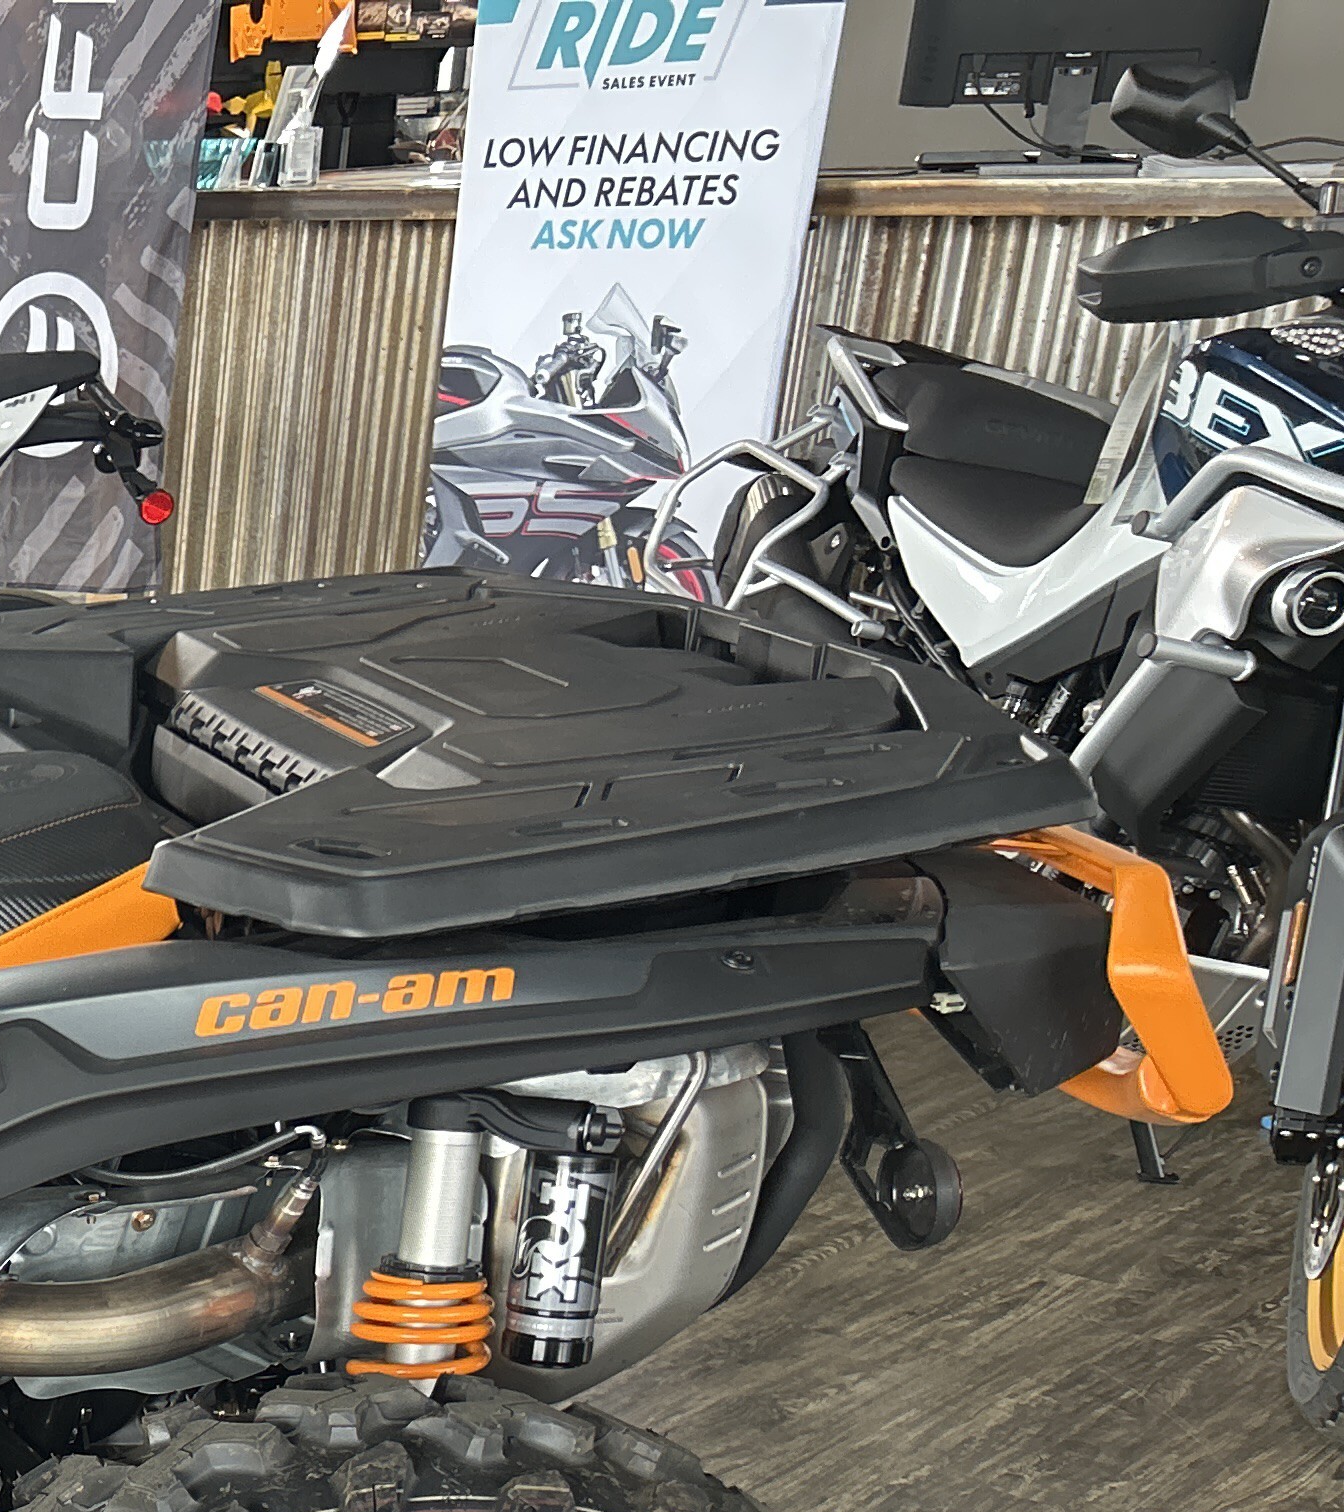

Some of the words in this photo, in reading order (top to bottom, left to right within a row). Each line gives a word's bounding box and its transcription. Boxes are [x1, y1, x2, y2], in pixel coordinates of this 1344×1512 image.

[536, 0, 723, 89] RIDE
[602, 75, 645, 90] SALES
[649, 73, 697, 88] EVENT
[27, 0, 113, 230] CF
[483, 135, 565, 169] LOW
[567, 129, 780, 165] FINANCING
[506, 177, 586, 209] AND
[594, 174, 740, 207] REBATES
[531, 218, 604, 250] ASK
[604, 218, 706, 249] NOW
[195, 967, 515, 1038] can-am
[526, 1182, 590, 1302] FOX
